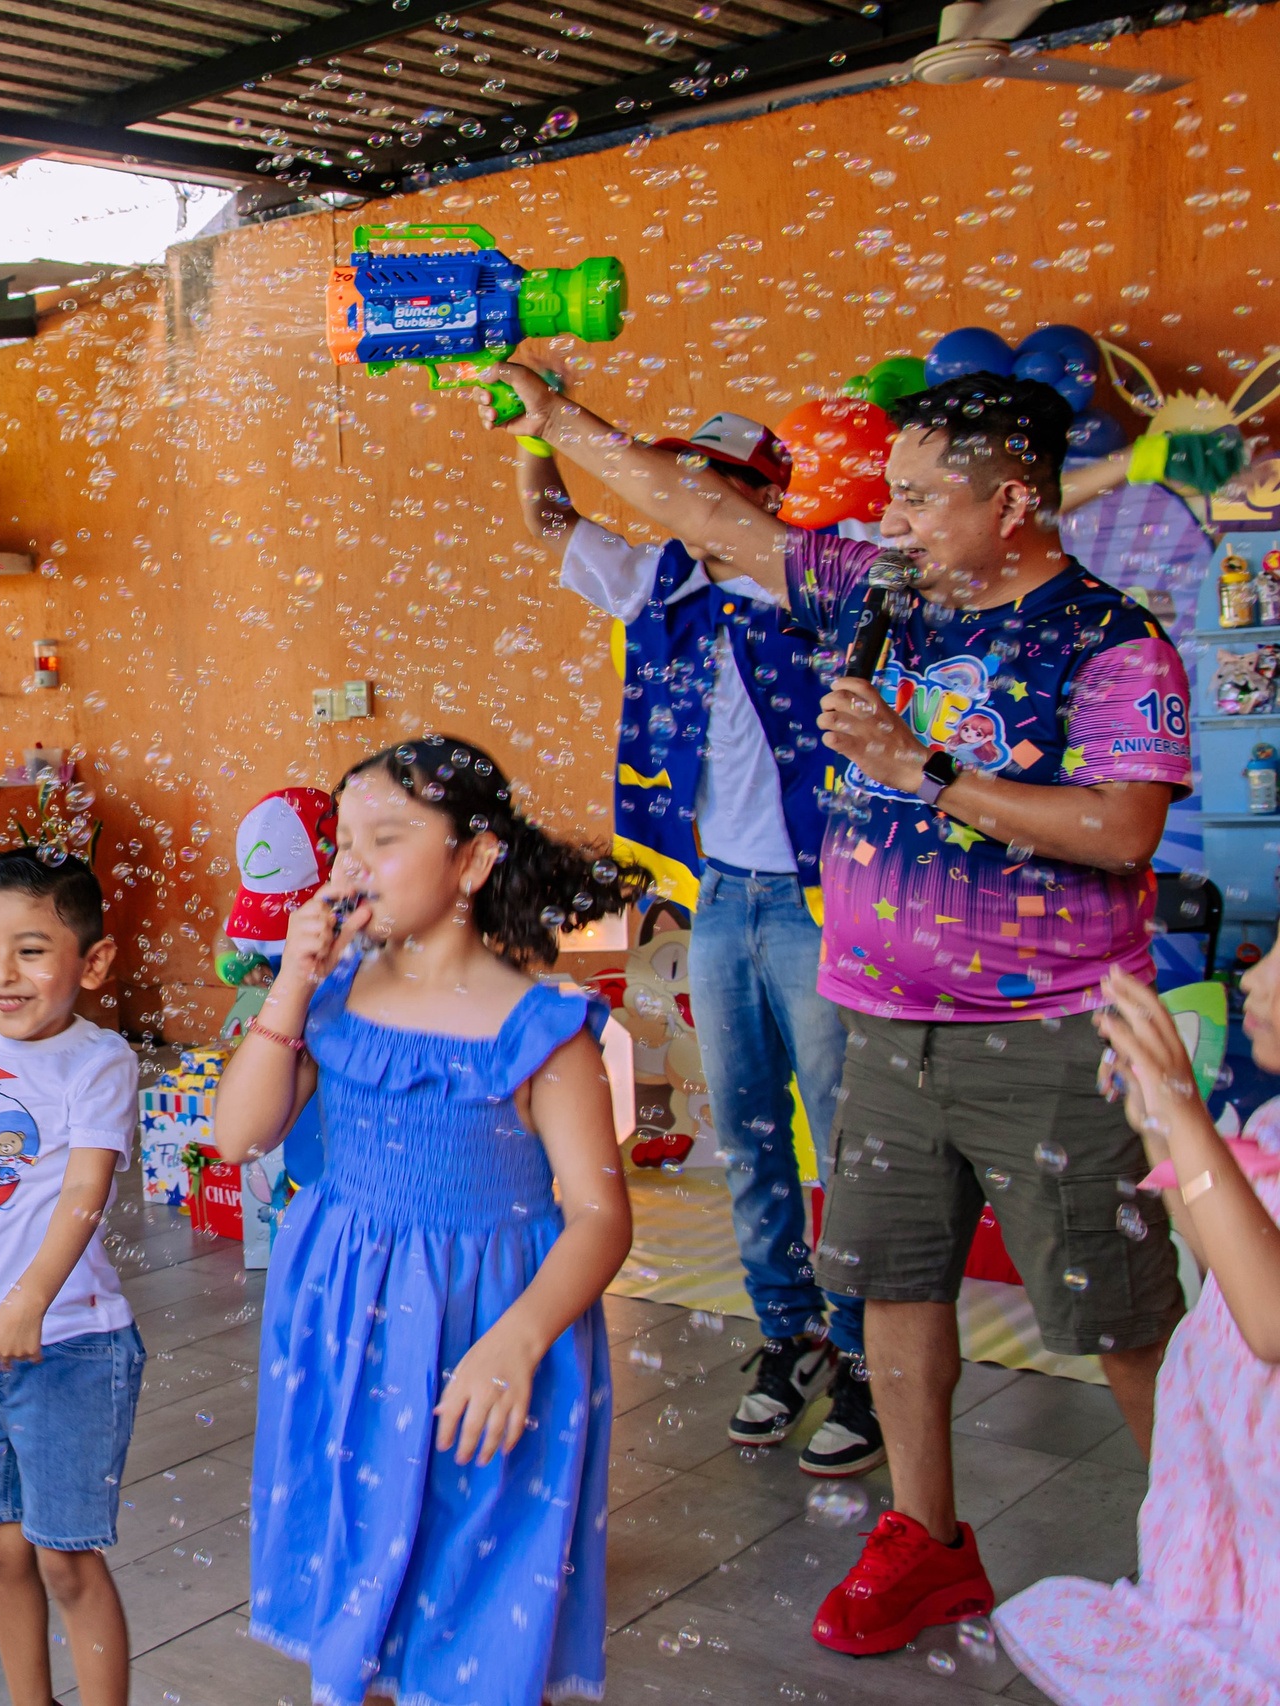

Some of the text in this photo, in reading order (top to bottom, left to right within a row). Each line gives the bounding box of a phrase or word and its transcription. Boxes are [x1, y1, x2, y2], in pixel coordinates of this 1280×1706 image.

[394, 318, 444, 329] Bubbles
[1133, 688, 1187, 739] 18
[1108, 737, 1191, 760] ANIVERSA
[205, 1185, 243, 1208] CHAP
